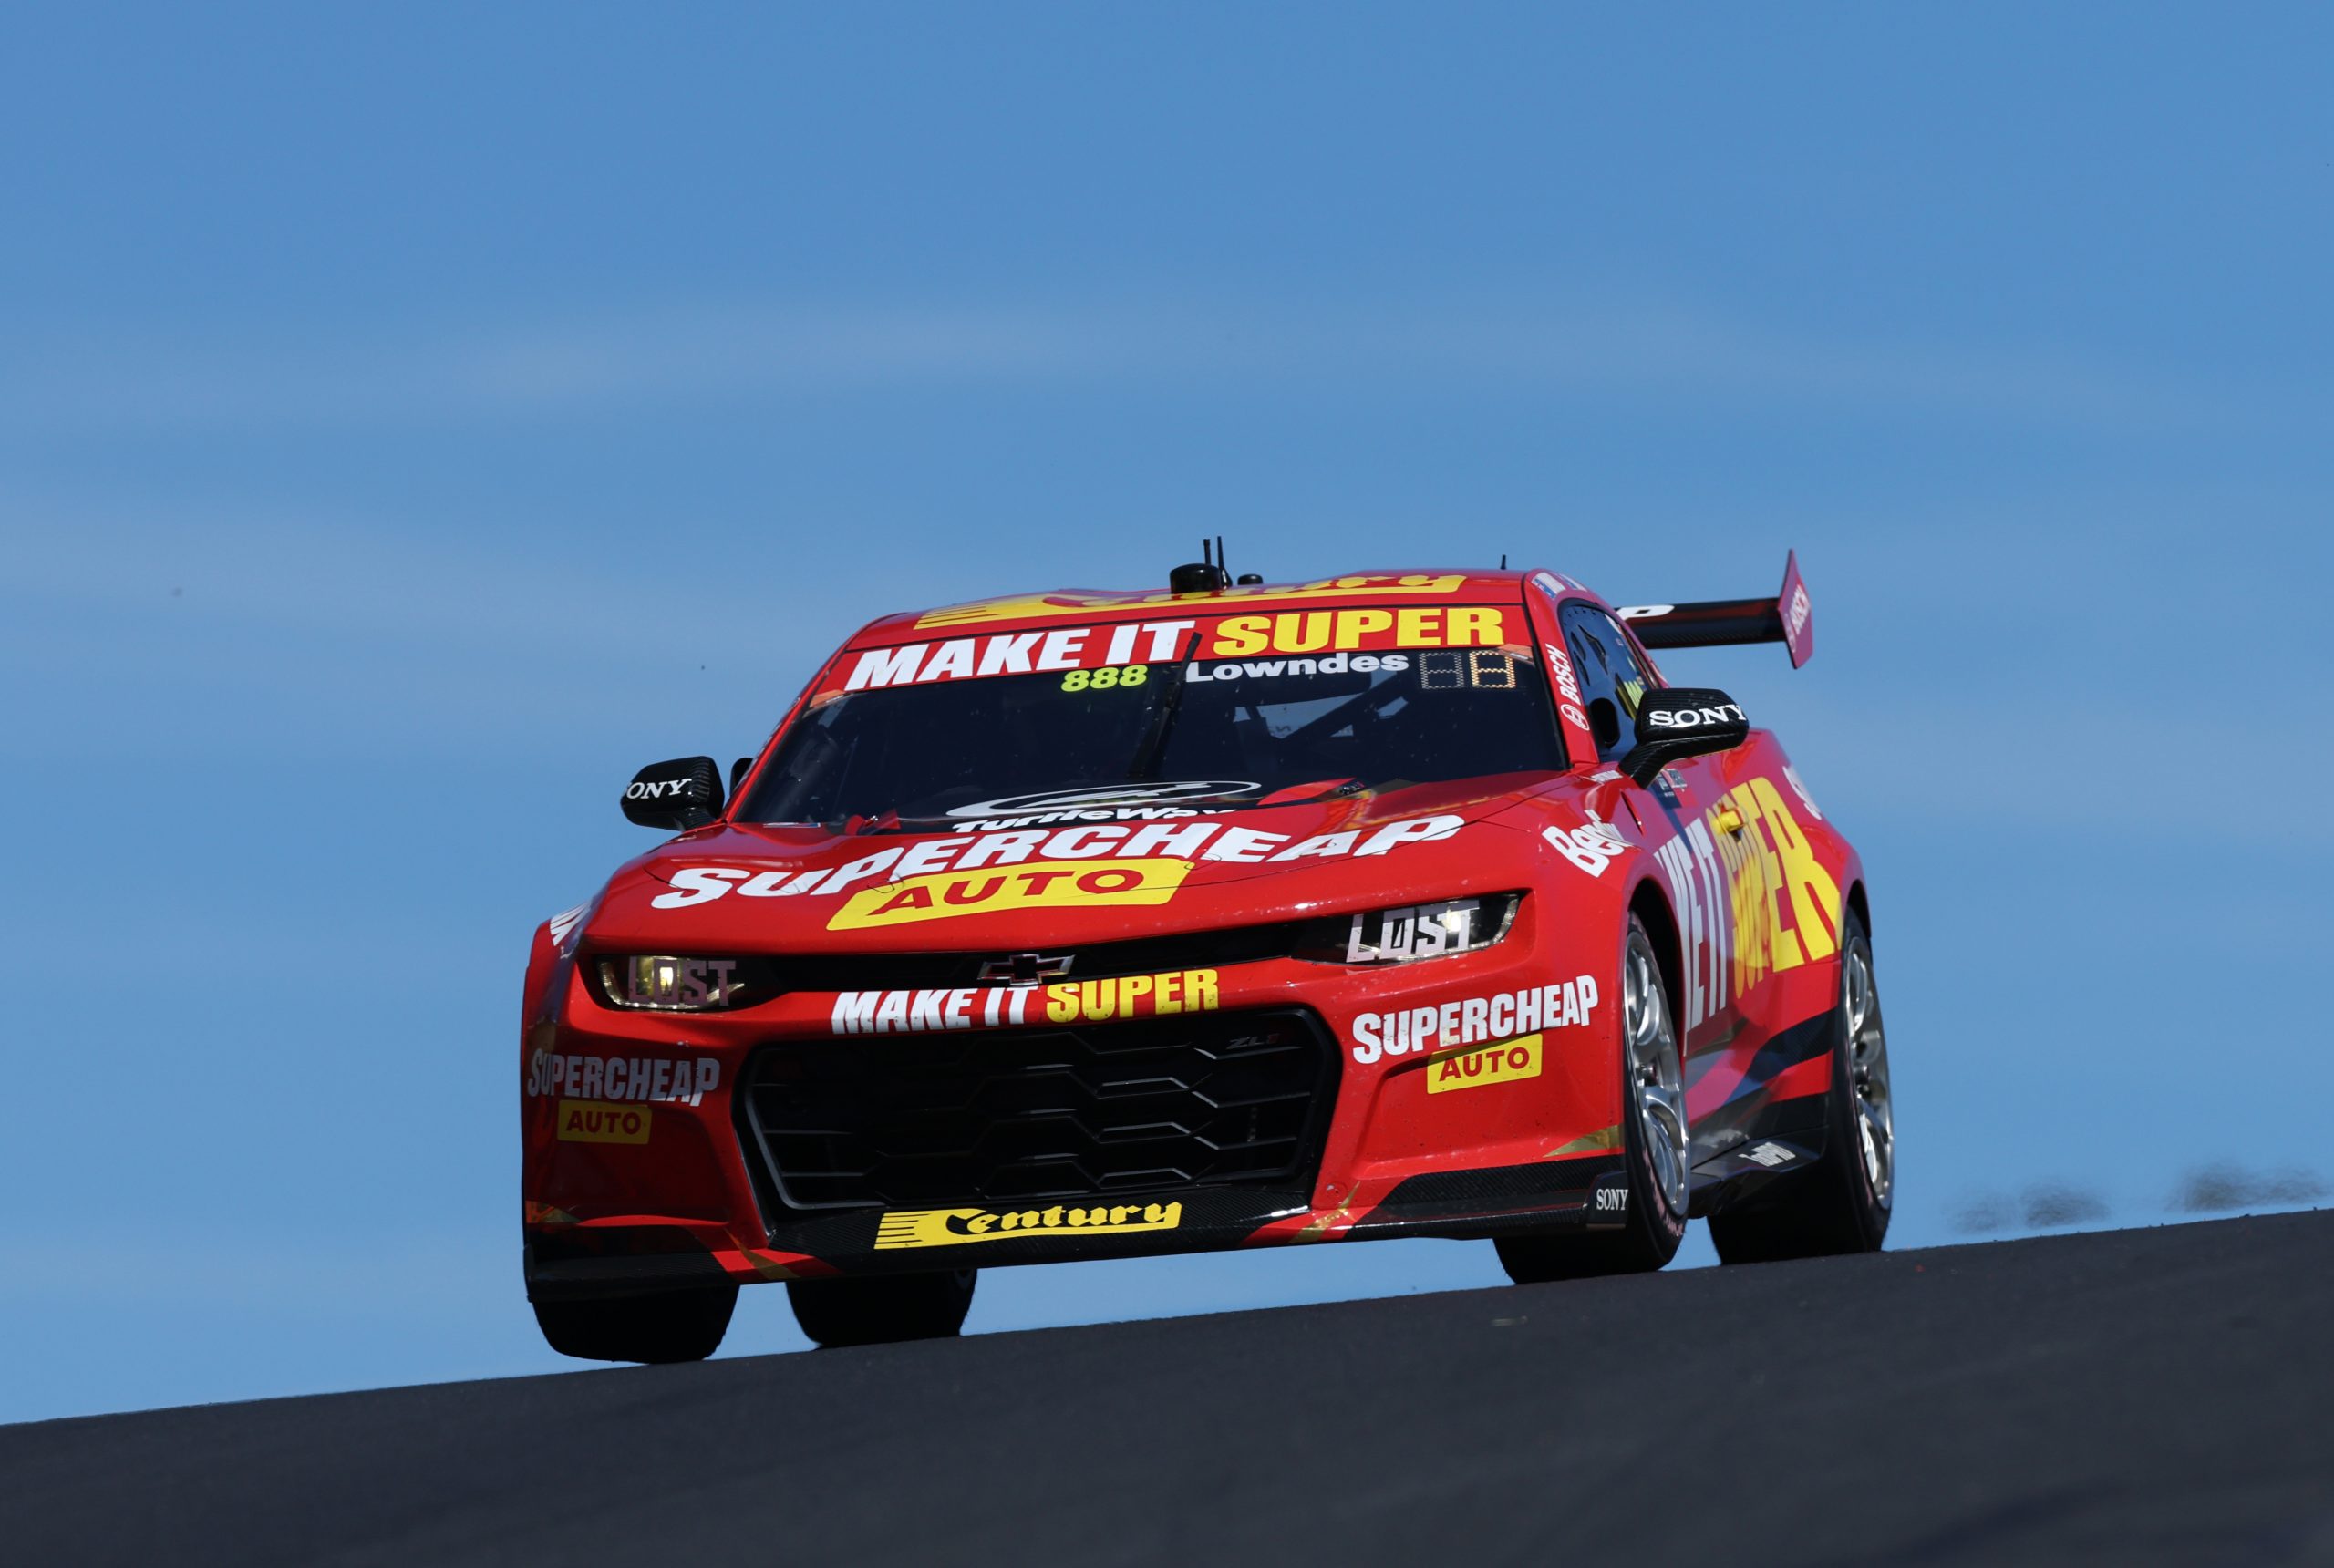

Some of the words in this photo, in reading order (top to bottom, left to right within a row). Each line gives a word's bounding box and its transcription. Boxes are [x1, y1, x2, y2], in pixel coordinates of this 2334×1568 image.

[845, 629, 1092, 691] MAKE
[1105, 620, 1195, 666] IT
[1213, 607, 1504, 656] SUPER
[1186, 652, 1410, 682] Lowndes
[1060, 665, 1148, 693] 888
[1545, 643, 1581, 706] BOSCH
[1649, 704, 1747, 727] SONY
[626, 778, 692, 799] ONY
[651, 814, 1464, 909] SUPERCHEAP
[875, 869, 1145, 915] AUTO
[831, 988, 973, 1034] MAKE
[983, 985, 1038, 1026] IT
[1047, 969, 1219, 1023] SUPER
[1352, 975, 1598, 1064] SUPERCHEAP
[527, 1048, 720, 1107] SUPERCHEAP
[1438, 1047, 1530, 1082] AUTO
[566, 1110, 641, 1135] AUTO
[1596, 1188, 1629, 1211] SONY
